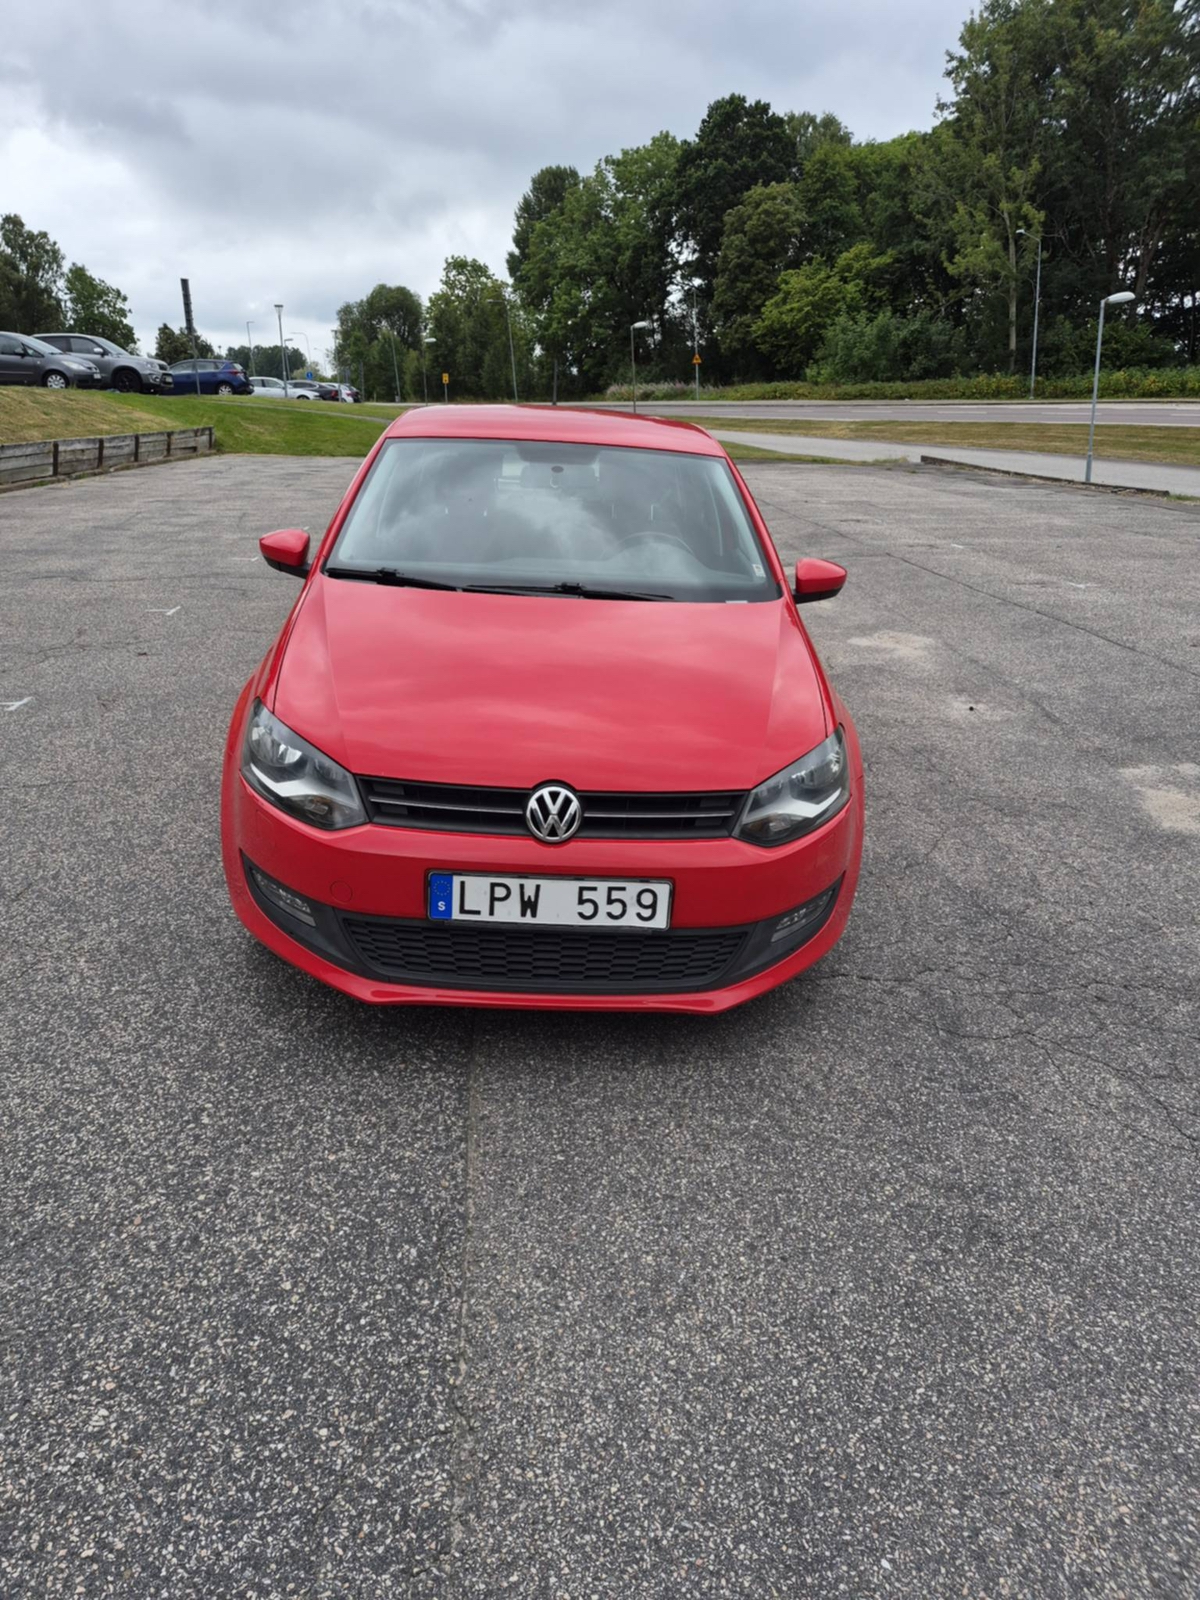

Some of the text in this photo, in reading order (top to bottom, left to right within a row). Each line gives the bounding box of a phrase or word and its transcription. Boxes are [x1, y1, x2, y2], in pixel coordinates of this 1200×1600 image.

[526, 786, 581, 841] VW
[437, 900, 446, 911] S
[459, 880, 659, 922] LPW 559
